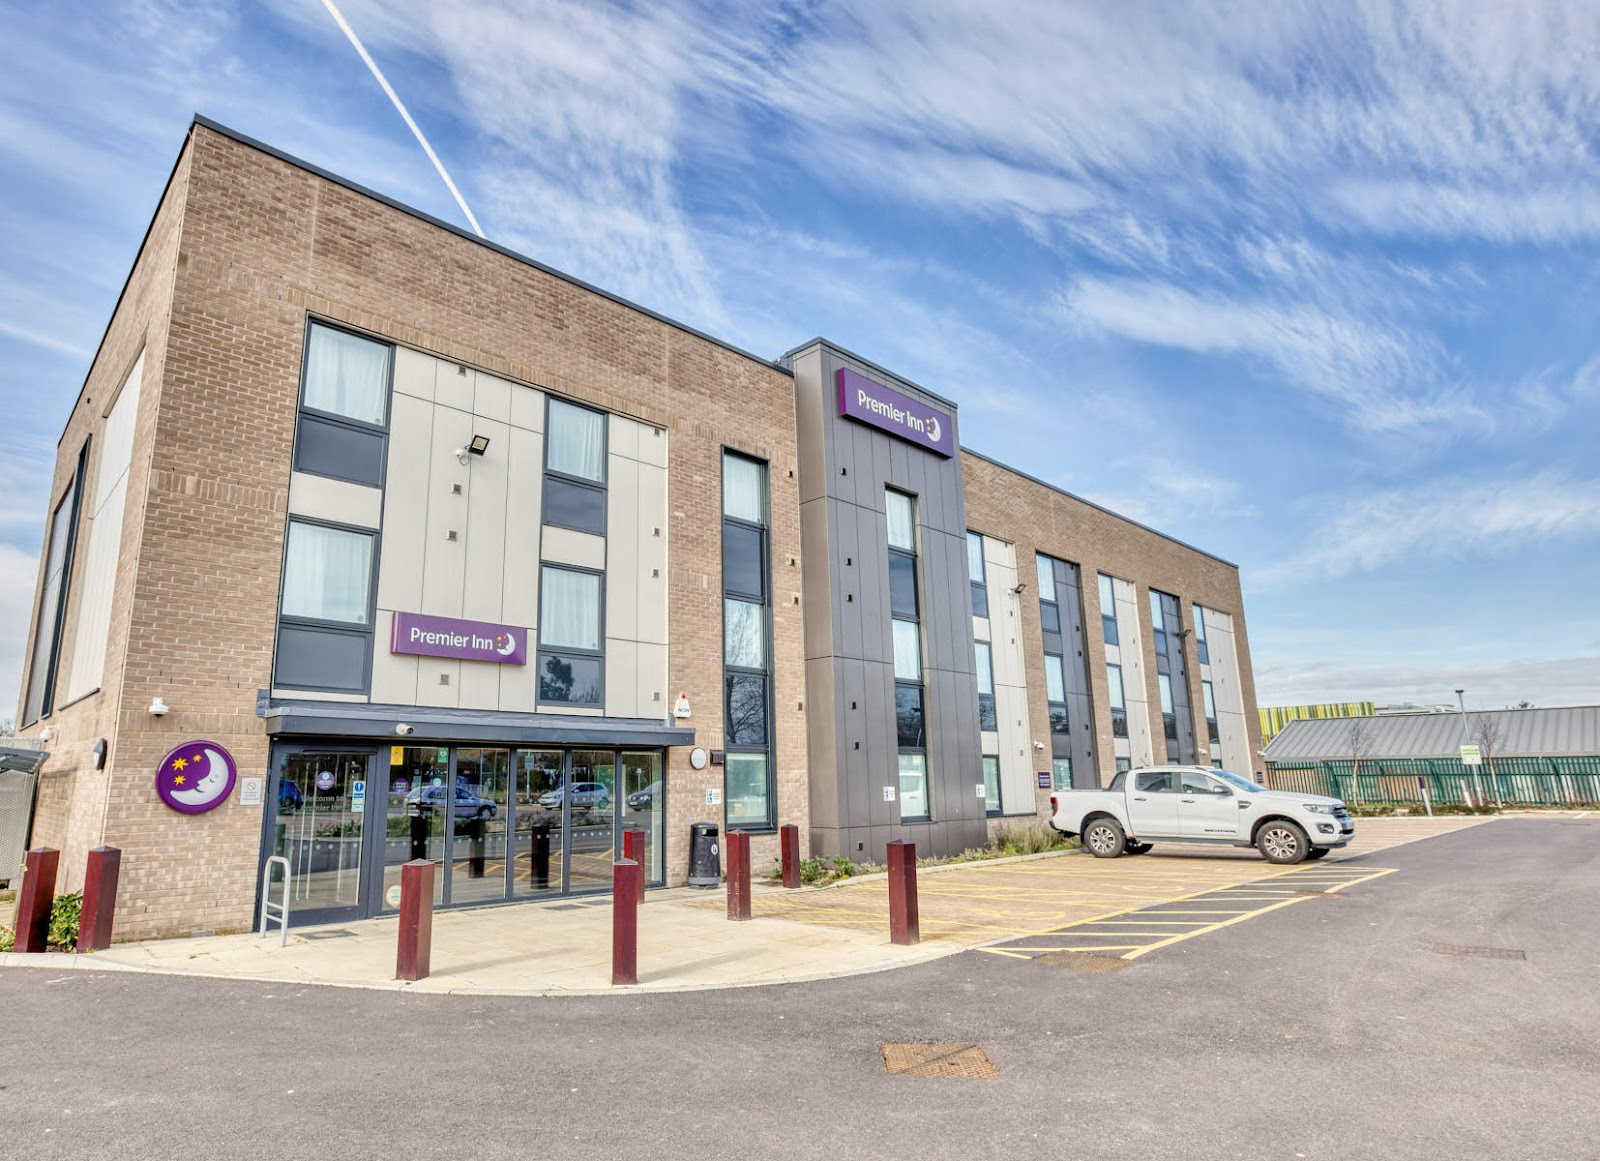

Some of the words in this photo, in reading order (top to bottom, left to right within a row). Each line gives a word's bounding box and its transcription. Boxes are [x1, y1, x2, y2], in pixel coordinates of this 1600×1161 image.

[858, 389, 905, 424] Premier
[906, 411, 924, 433] Inn
[410, 627, 469, 648] Premier
[472, 634, 493, 650] Inn
